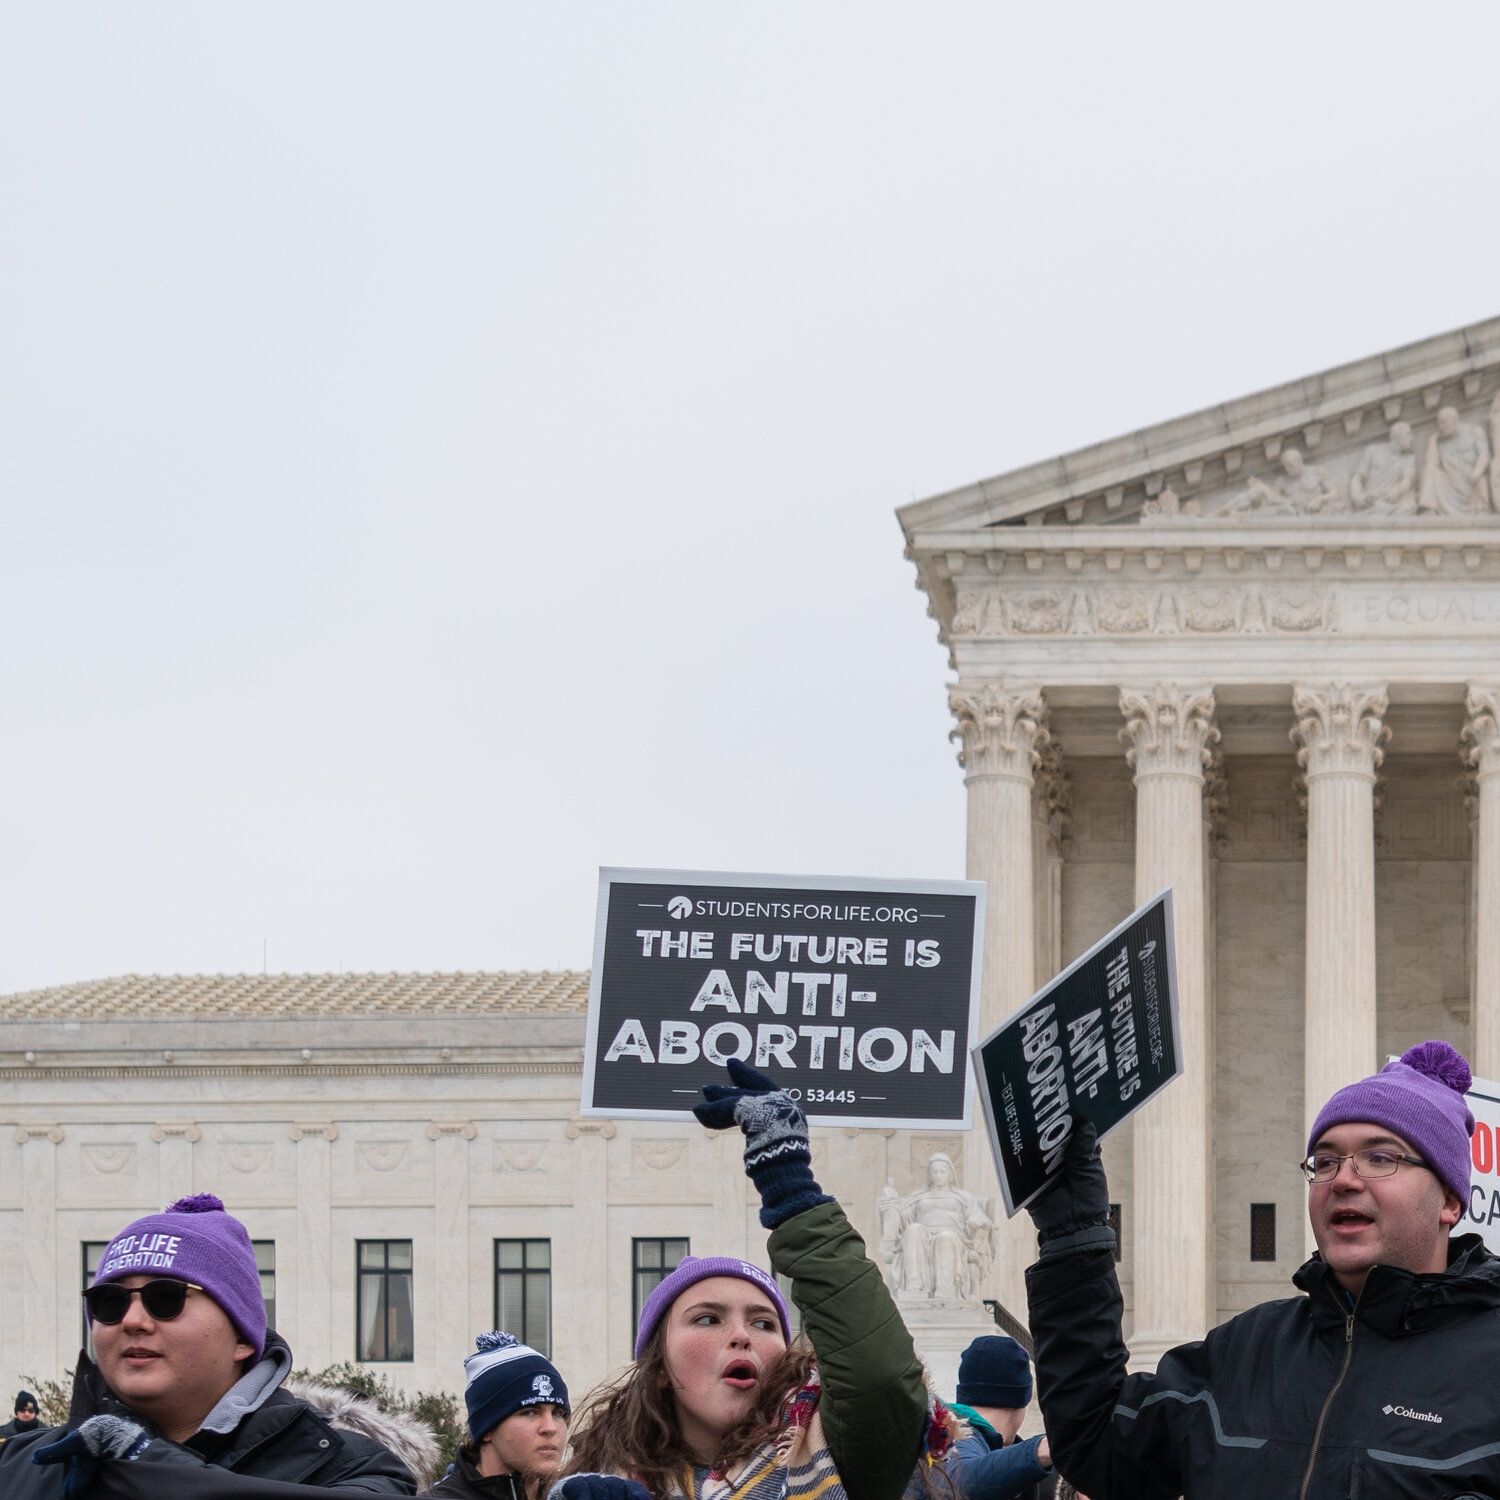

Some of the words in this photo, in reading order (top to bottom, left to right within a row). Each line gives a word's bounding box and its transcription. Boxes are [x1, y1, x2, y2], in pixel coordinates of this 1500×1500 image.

[1365, 594, 1482, 625] EQUAL
[696, 900, 918, 924] STUDENTSFORLIFE.ORG
[636, 929, 714, 960] THE
[730, 933, 888, 966] FUTURE
[904, 939, 941, 968] IS
[1106, 946, 1130, 1000] THE
[690, 969, 877, 1018] ANTI-
[604, 1019, 955, 1074] ABORTION
[1067, 1007, 1109, 1099] ANTI-
[1110, 992, 1139, 1080] FUTURE
[807, 1088, 856, 1104] 53445
[1019, 1002, 1073, 1175] ABORTION
[1119, 1072, 1142, 1101] IS
[101, 1251, 175, 1277] GENERATION
[107, 1233, 182, 1261] PRO-LIFE
[1394, 1405, 1443, 1424] Columbia
